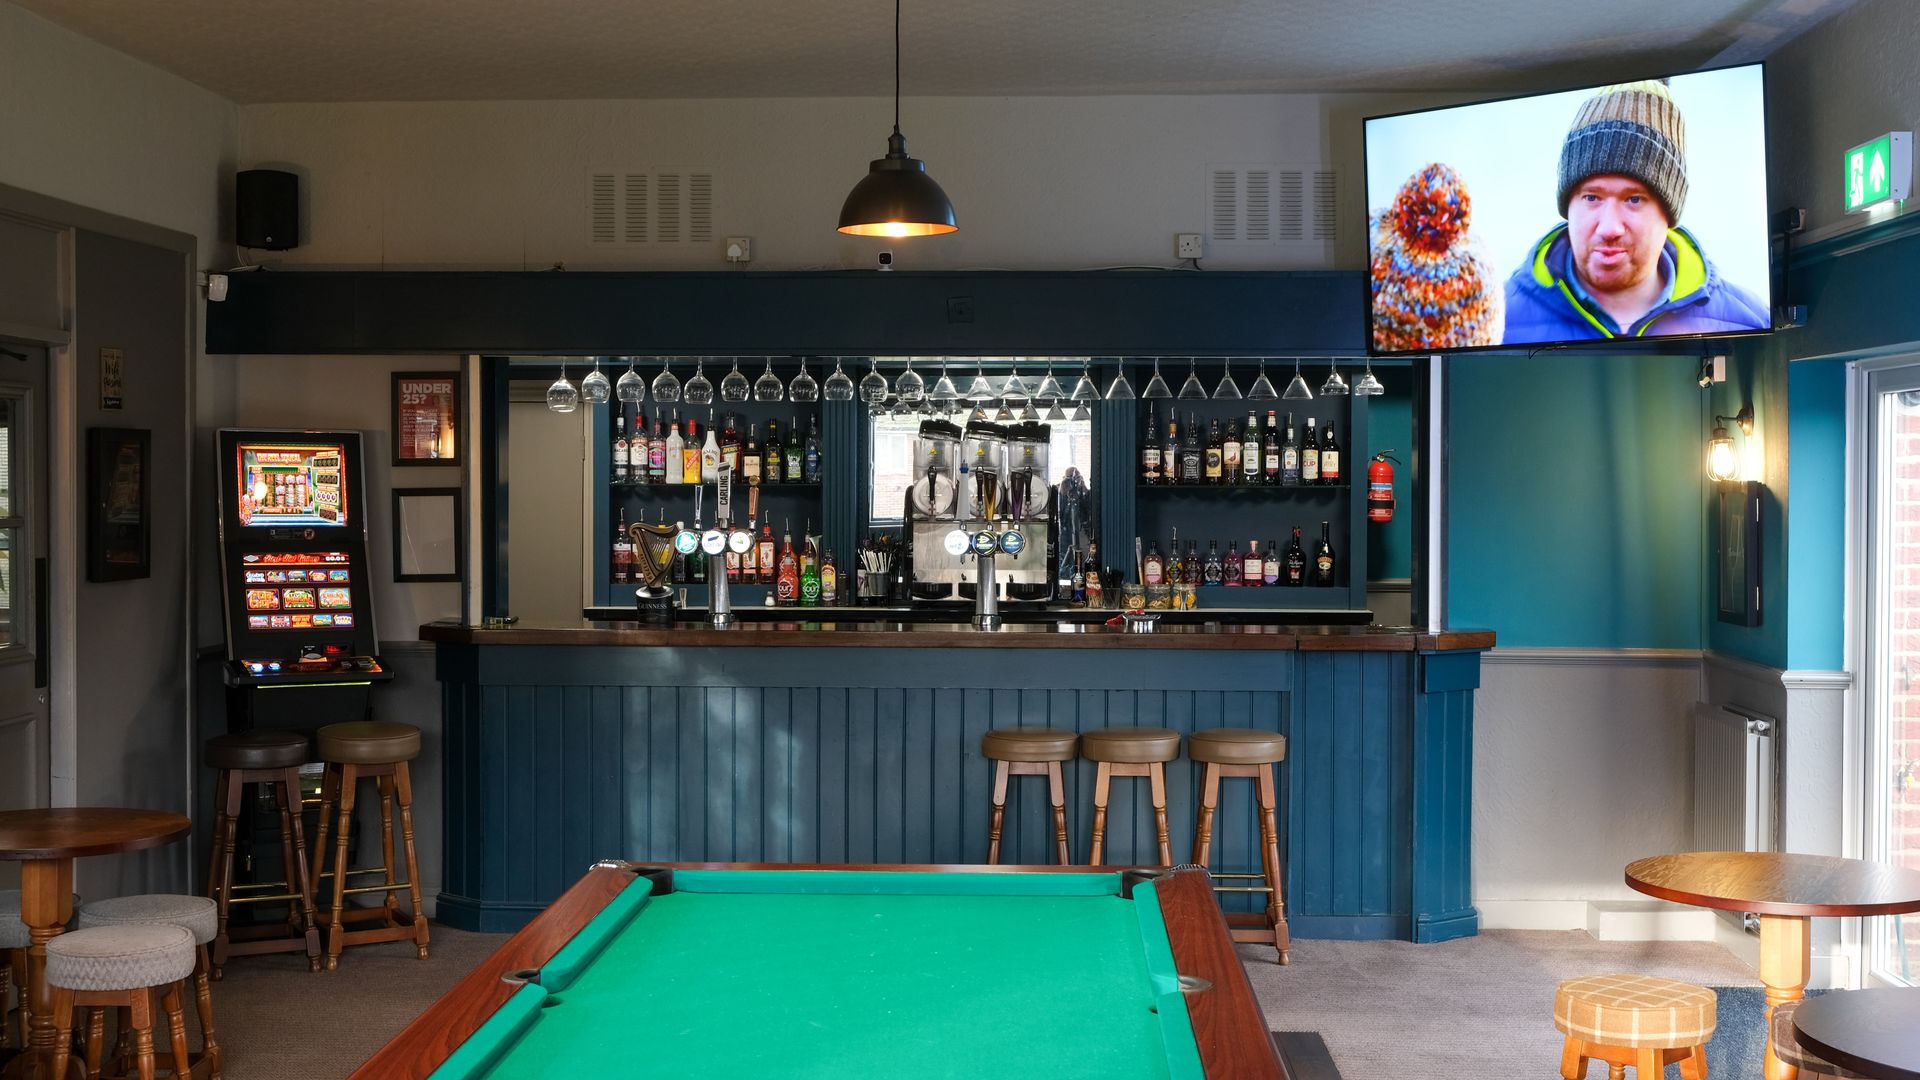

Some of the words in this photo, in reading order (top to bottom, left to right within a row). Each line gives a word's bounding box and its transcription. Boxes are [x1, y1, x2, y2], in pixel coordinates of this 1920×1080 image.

[402, 383, 452, 394] UNDER
[402, 394, 427, 405] 25?
[719, 475, 729, 506] CARLING
